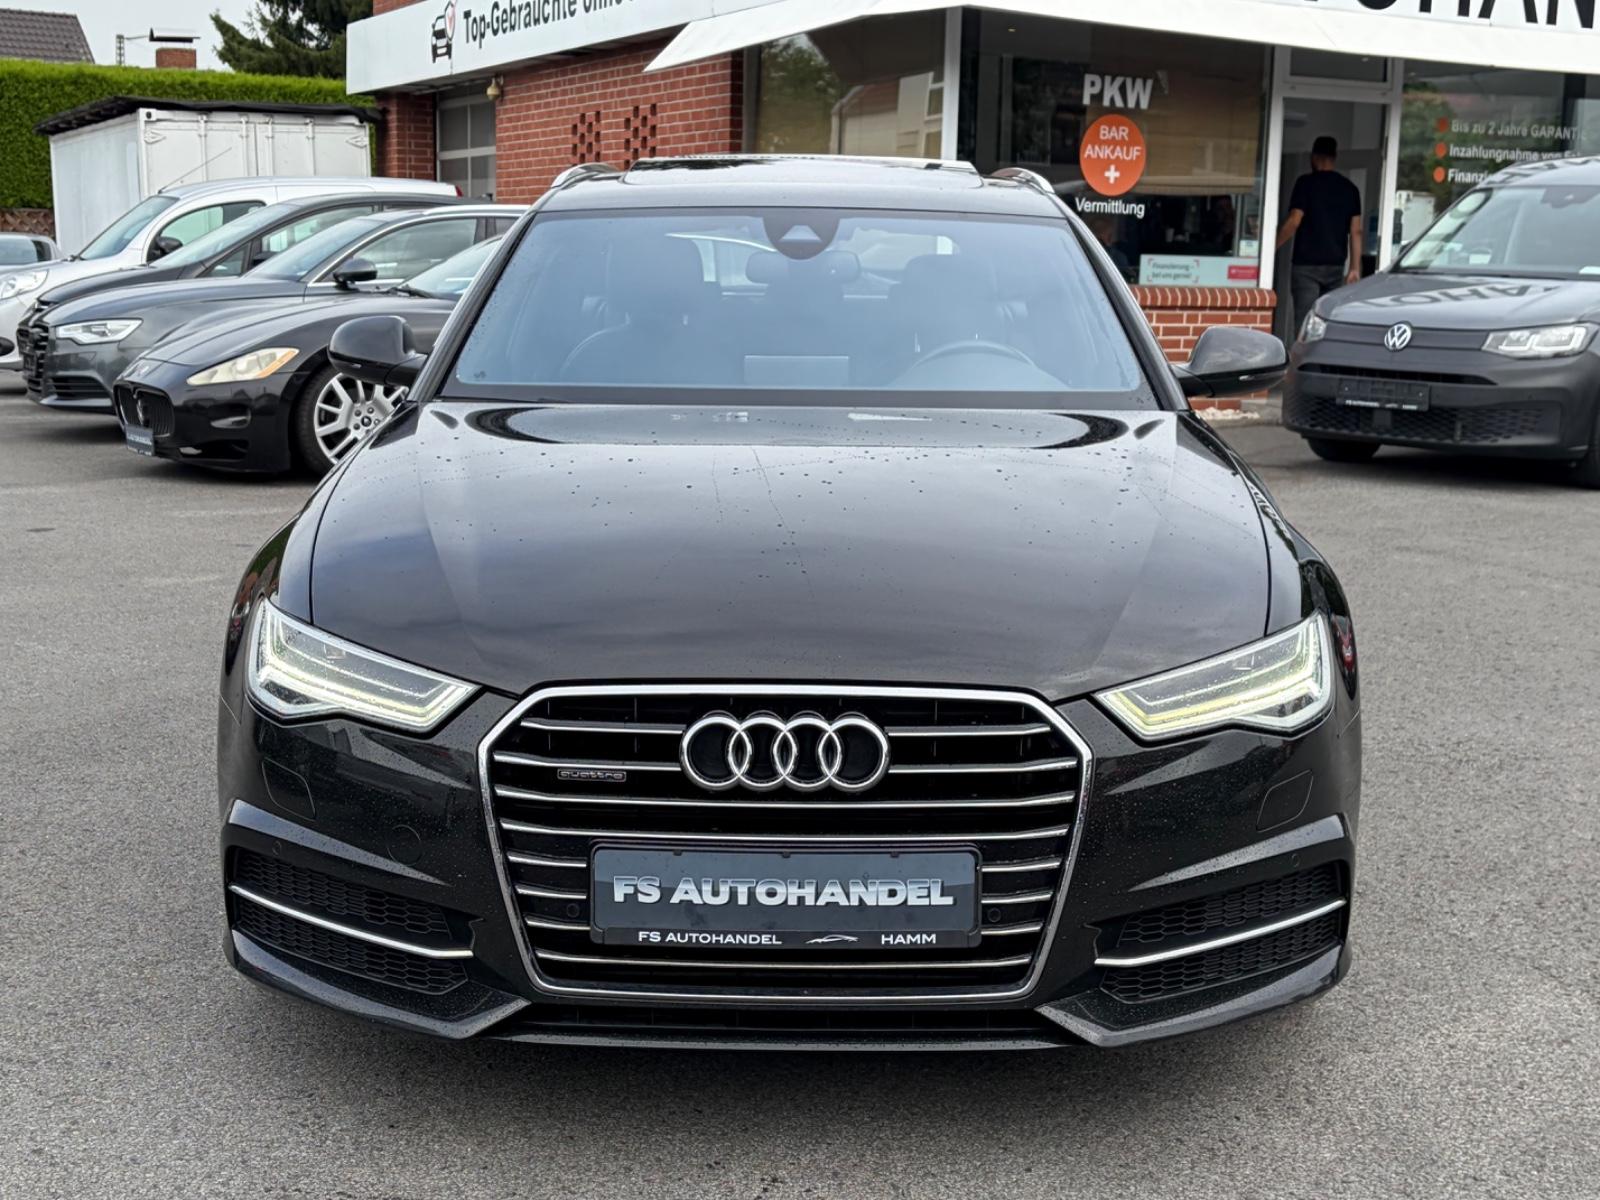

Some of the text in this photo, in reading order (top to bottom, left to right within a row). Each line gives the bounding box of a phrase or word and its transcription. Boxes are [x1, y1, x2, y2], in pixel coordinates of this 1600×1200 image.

[463, 0, 577, 49] Top-Gebrauchte
[1082, 73, 1154, 110] PKW
[1100, 125, 1129, 141] BAR
[1451, 119, 1469, 132] Bis
[1488, 121, 1496, 135] 2
[1084, 144, 1142, 160] ANKAUF
[1449, 144, 1539, 163] Inzahlungnahme
[1075, 197, 1146, 219] Vermittlung
[613, 876, 954, 907] FS AUTOHANDEL
[638, 931, 936, 945] FS AUTOHANDEL HAMM
